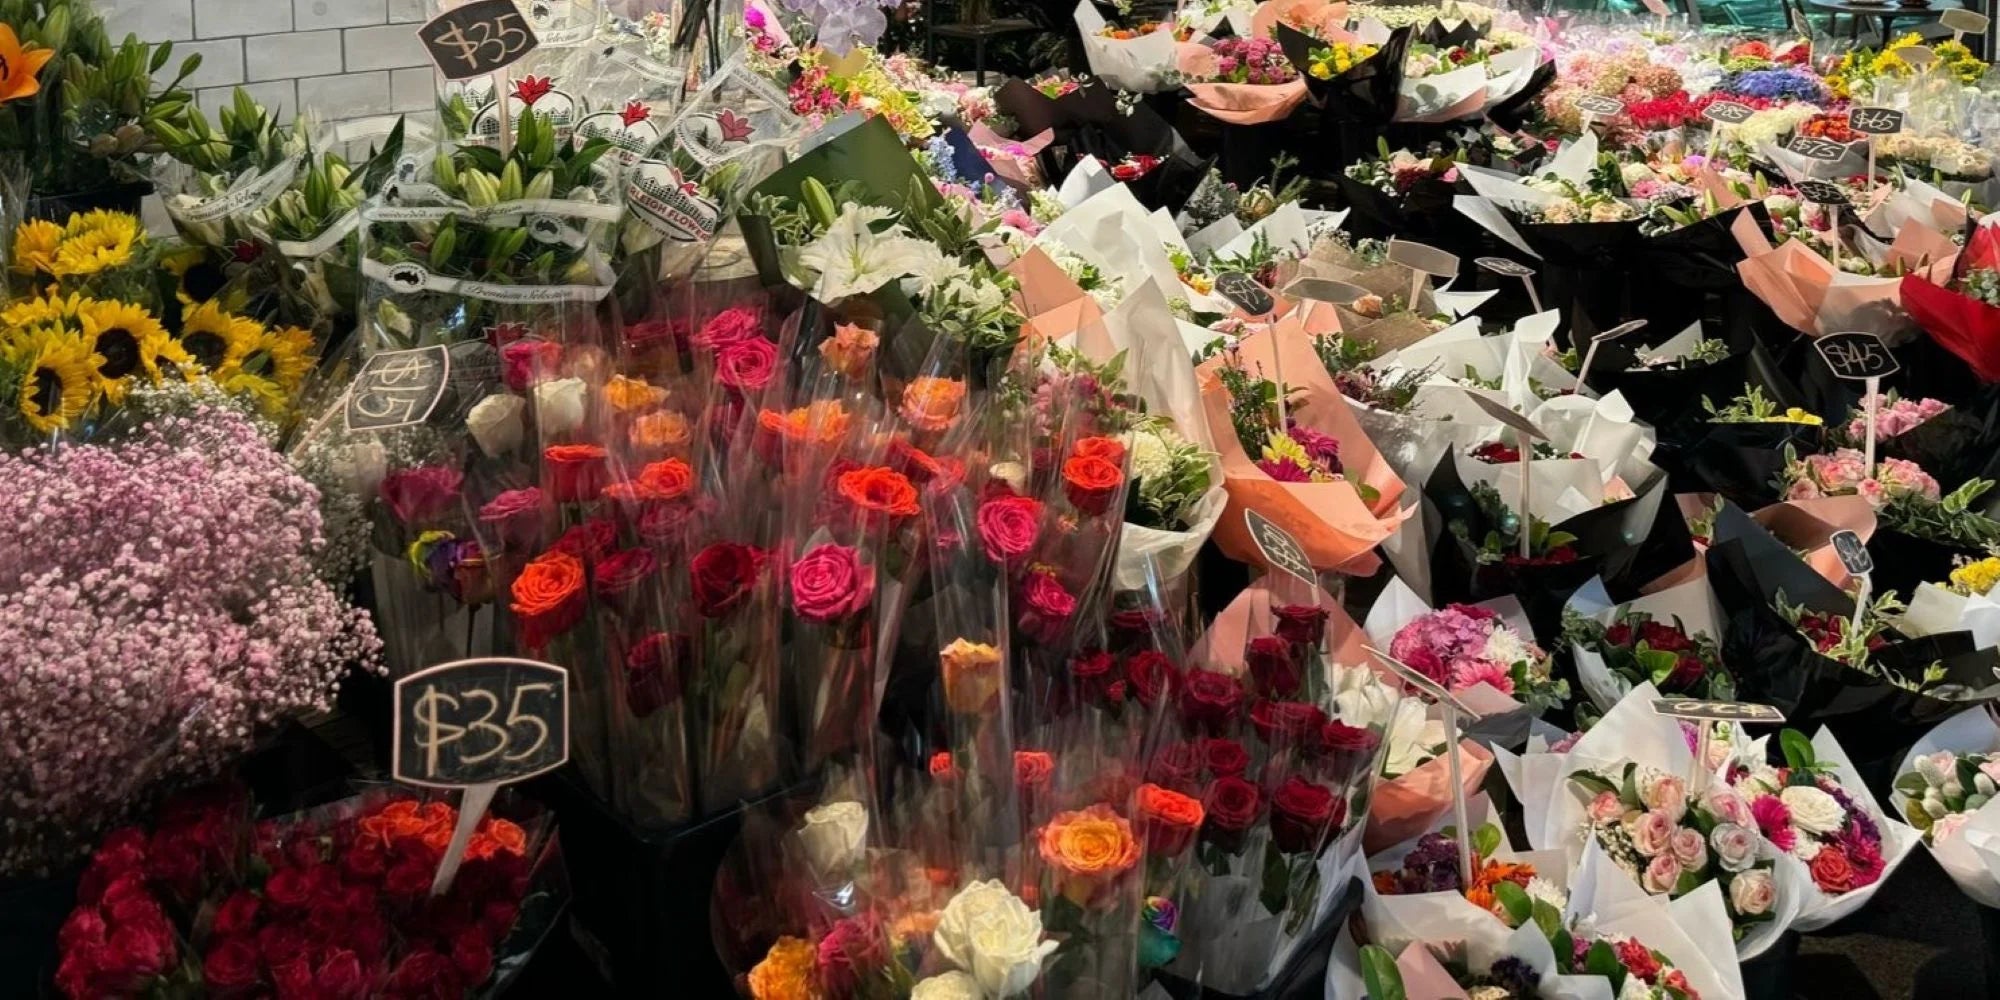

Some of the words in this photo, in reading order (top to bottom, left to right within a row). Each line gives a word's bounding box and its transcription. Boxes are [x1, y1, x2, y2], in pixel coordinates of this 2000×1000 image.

[433, 13, 527, 69] $35
[1854, 109, 1900, 130] $65
[1793, 137, 1842, 157] $75
[1823, 340, 1884, 374] $45
[356, 356, 434, 422] $15
[413, 684, 554, 777] $35
